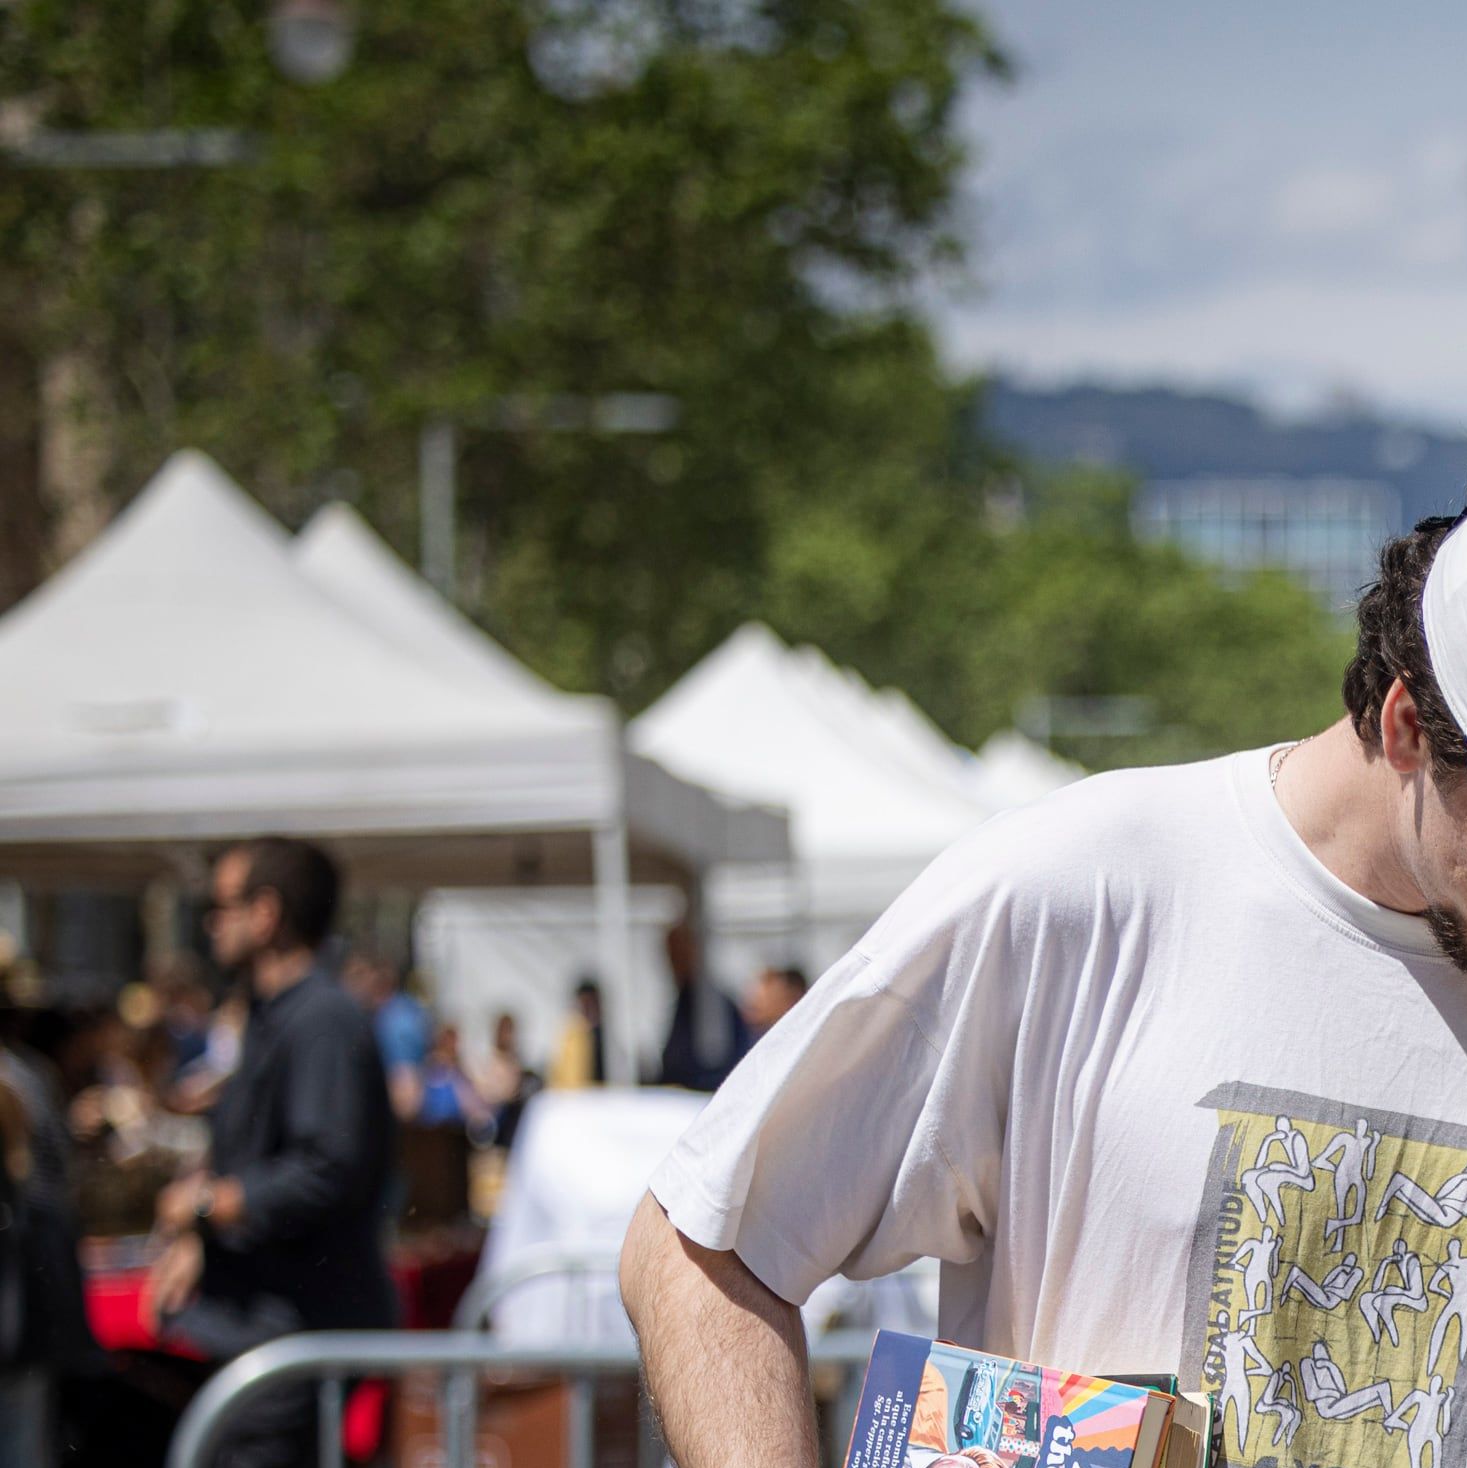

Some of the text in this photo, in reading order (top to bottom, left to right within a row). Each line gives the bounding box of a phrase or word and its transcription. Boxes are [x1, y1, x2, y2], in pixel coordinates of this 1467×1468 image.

[895, 1390, 904, 1402] al
[871, 1394, 884, 1416] Sgt.
[883, 1397, 892, 1412] en
[880, 1415, 889, 1426] la
[887, 1403, 900, 1427] que
[899, 1402, 911, 1424] Ese
[886, 1428, 895, 1442] se
